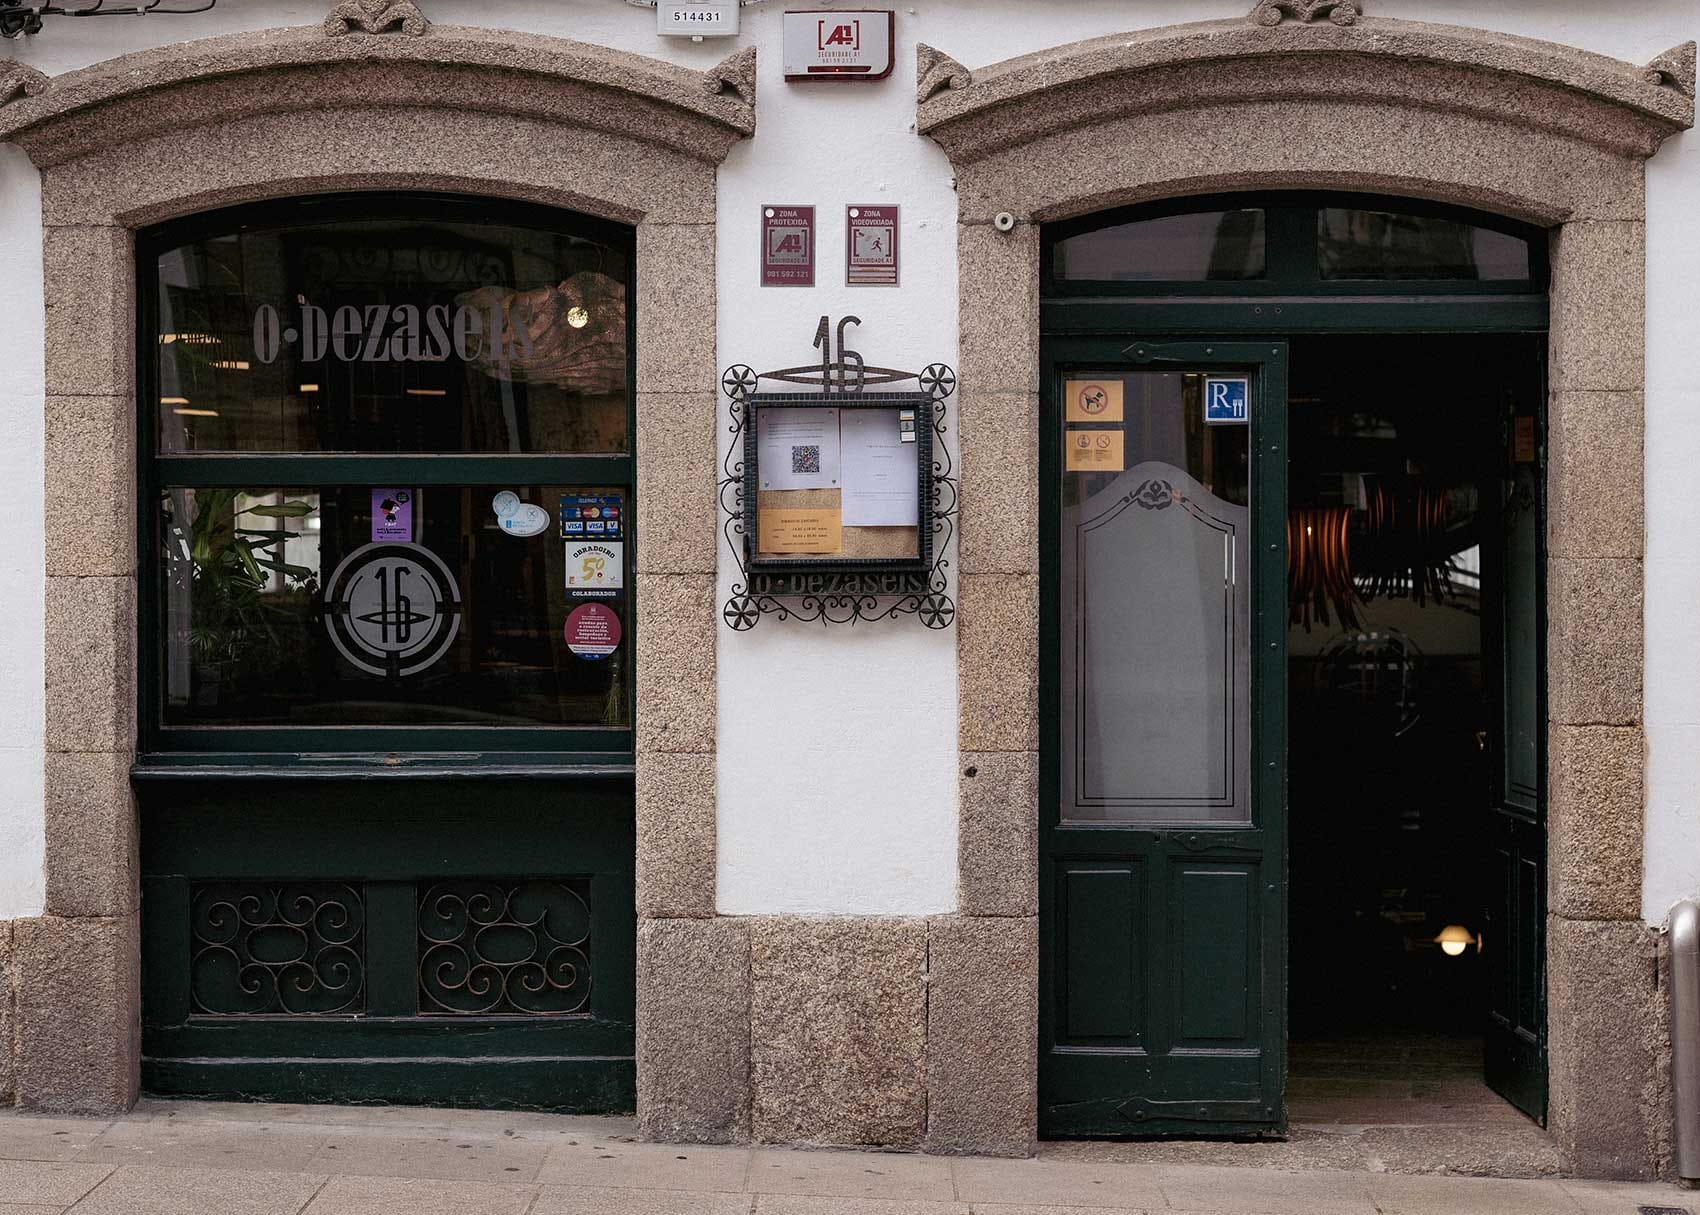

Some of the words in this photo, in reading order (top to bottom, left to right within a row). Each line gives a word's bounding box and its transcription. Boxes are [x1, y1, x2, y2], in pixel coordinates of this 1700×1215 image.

[674, 12, 719, 21] 514431
[812, 315, 865, 394] 16
[1211, 383, 1232, 409] R
[573, 545, 616, 559] OBRADOIRO
[374, 566, 412, 644] 16
